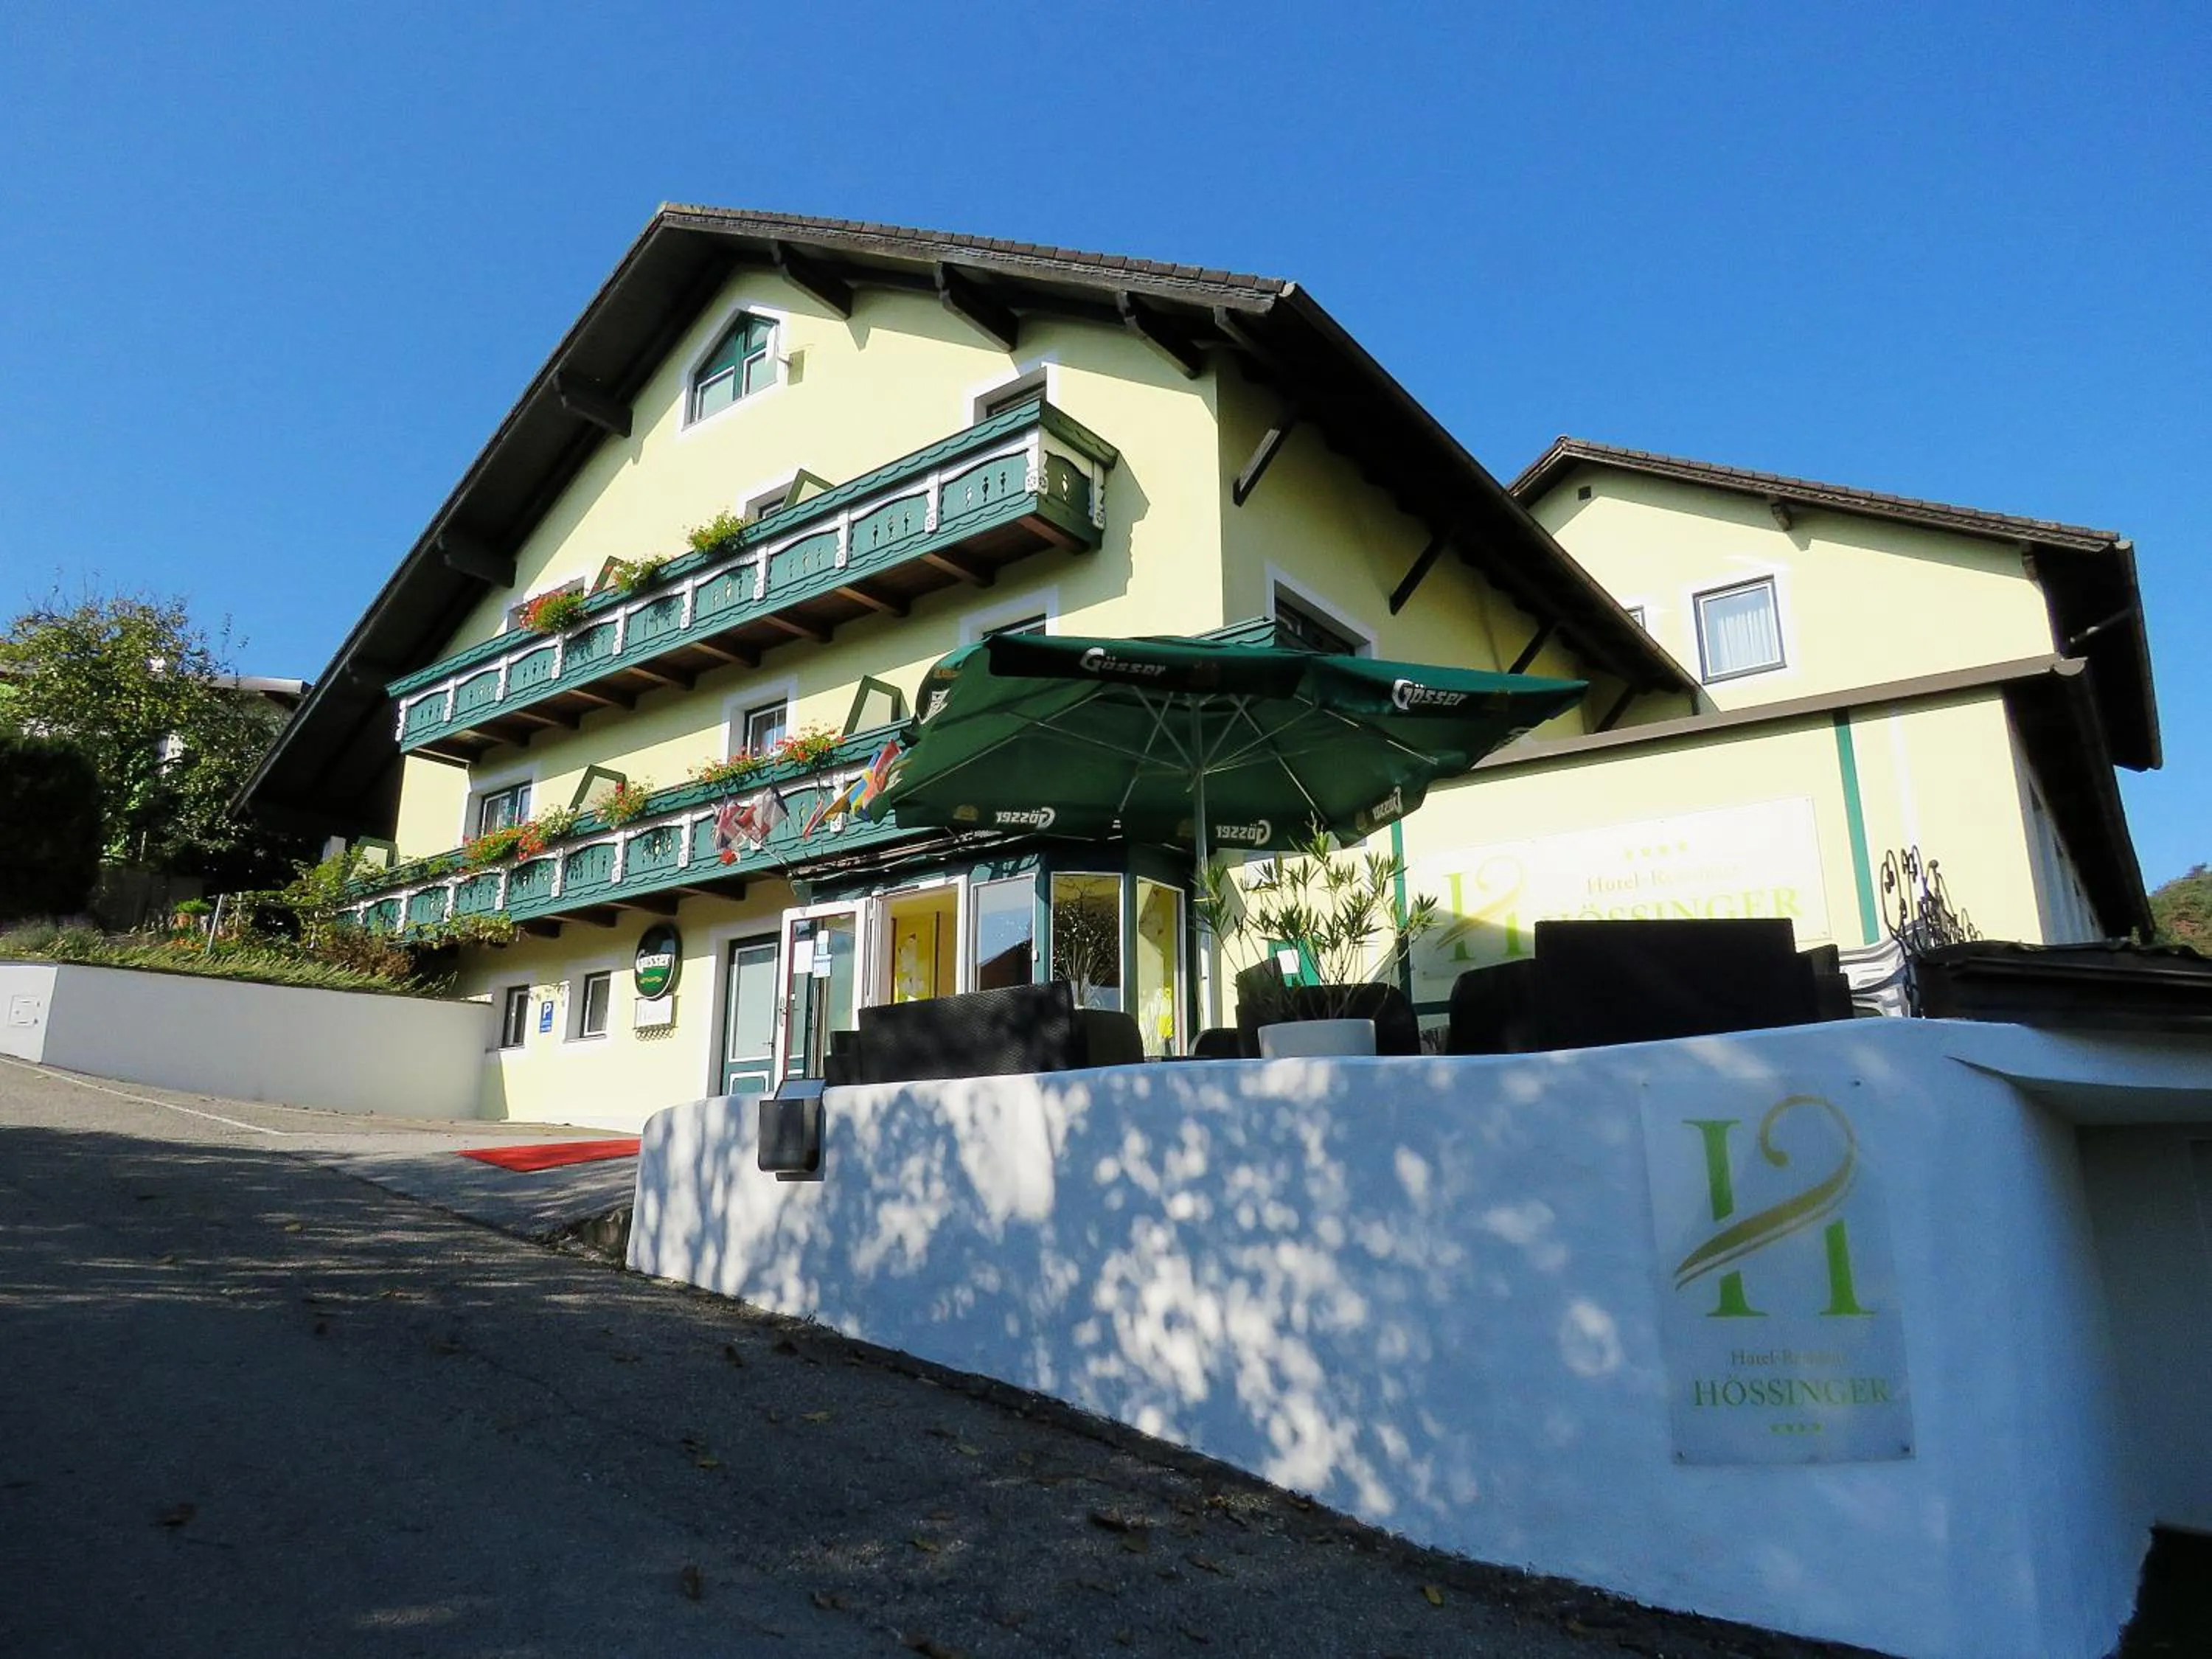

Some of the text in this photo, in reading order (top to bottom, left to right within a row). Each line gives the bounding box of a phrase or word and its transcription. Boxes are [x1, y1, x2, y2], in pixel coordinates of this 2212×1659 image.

[1079, 647, 1166, 676] Gösser
[1392, 678, 1469, 710] Gösser
[543, 1002, 552, 1019] P
[1694, 1372, 1891, 1407] HÖSSINGER
